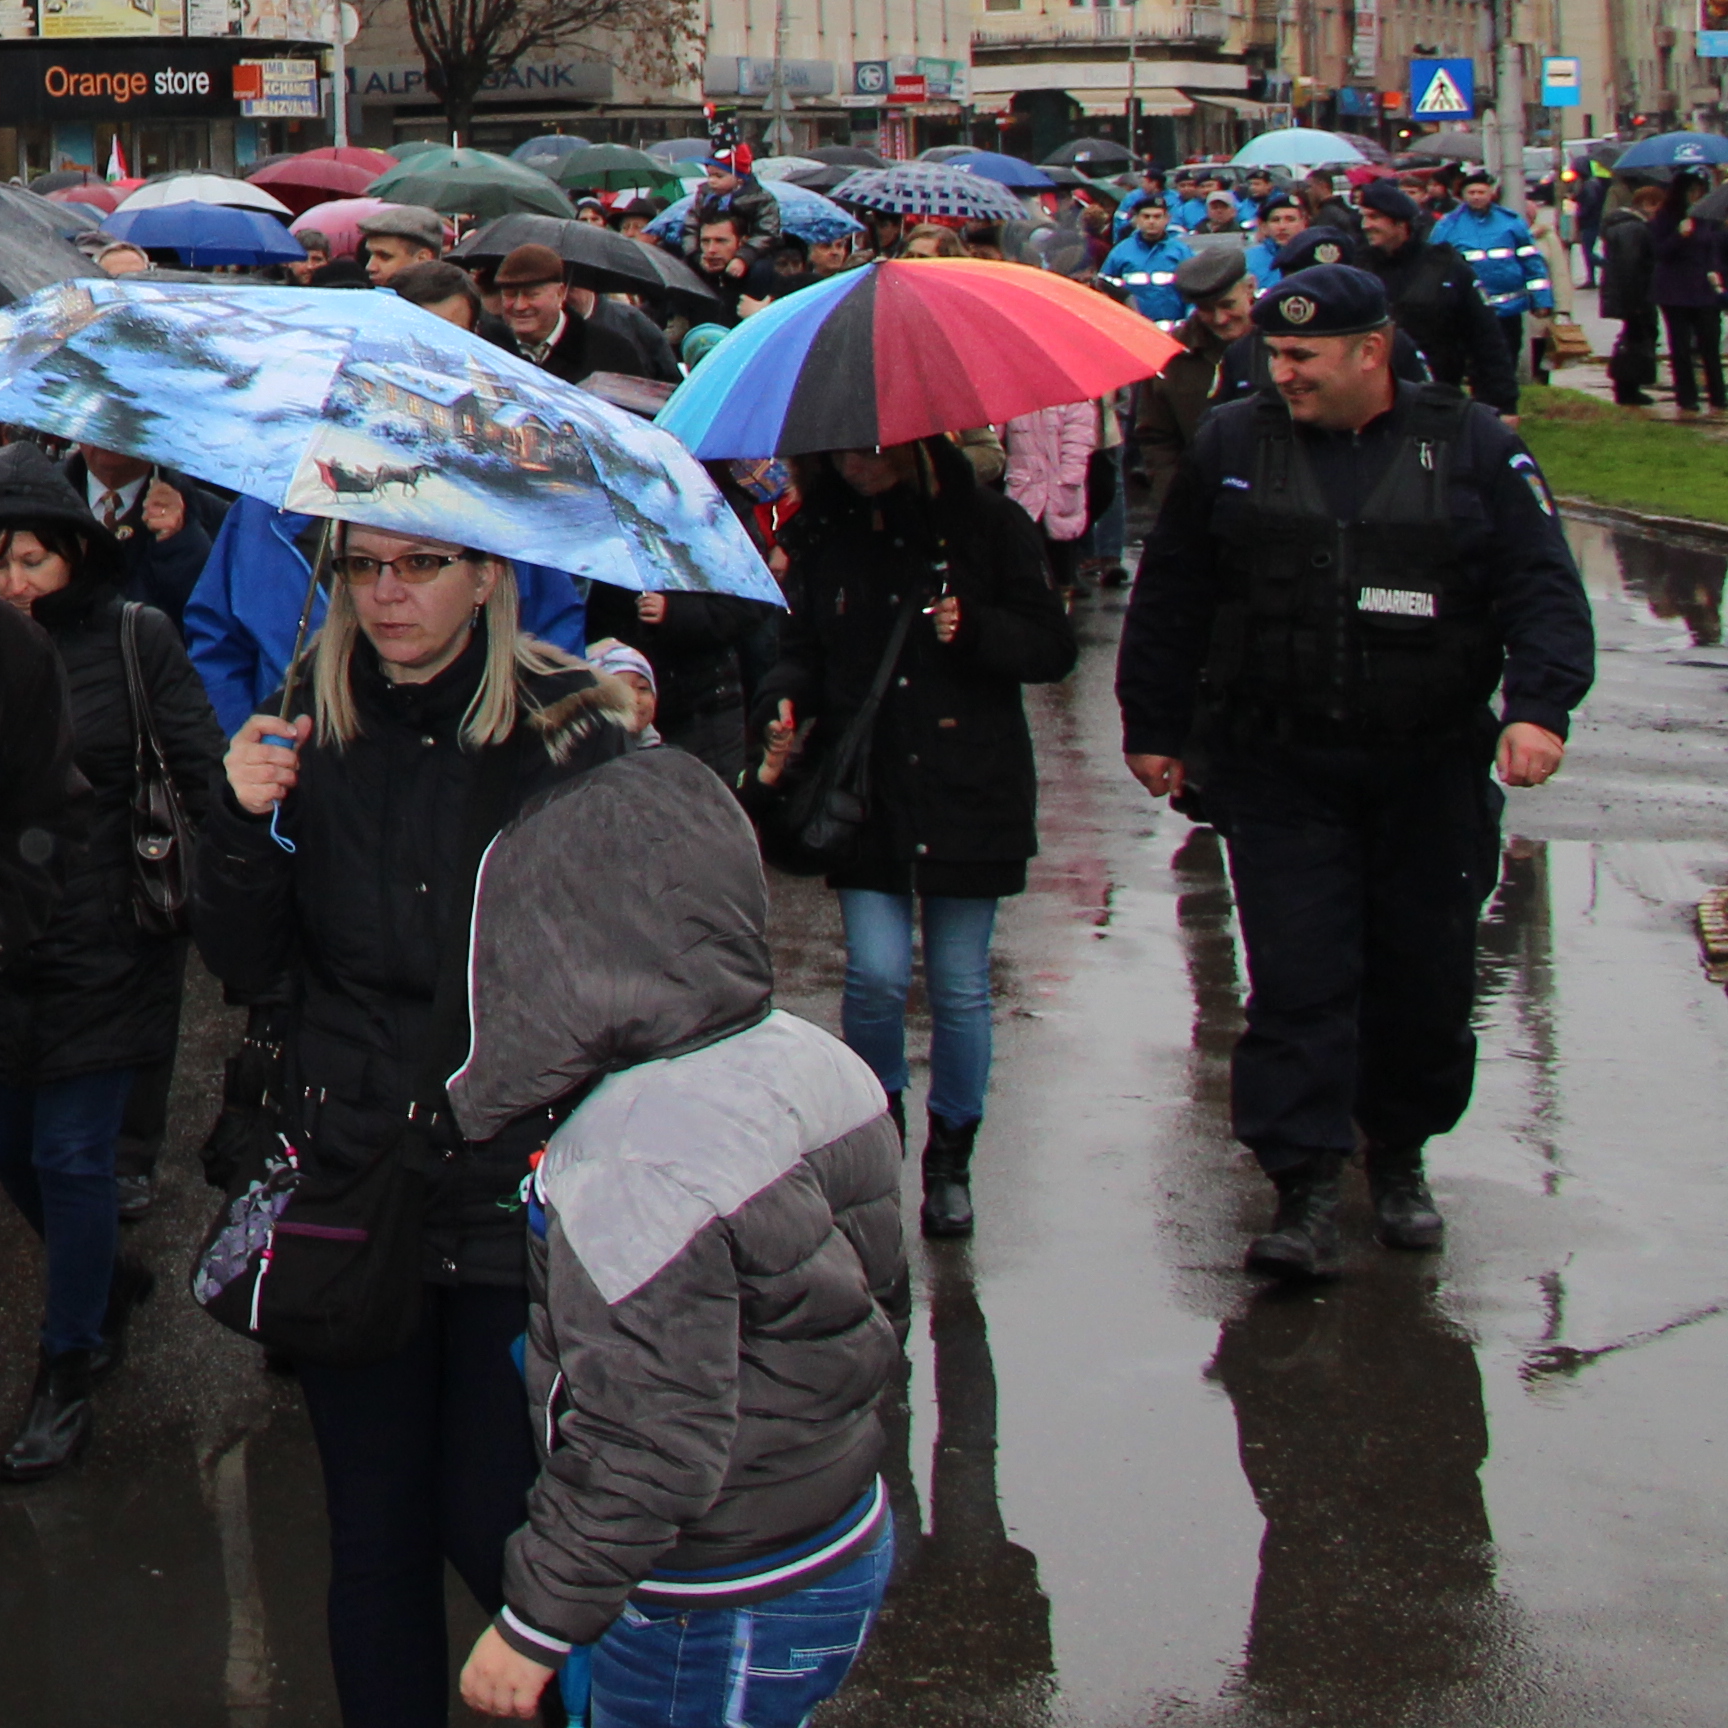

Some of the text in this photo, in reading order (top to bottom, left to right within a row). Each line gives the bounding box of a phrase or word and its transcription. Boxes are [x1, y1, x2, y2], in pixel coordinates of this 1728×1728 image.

[45, 65, 210, 103] Orange store
[261, 81, 311, 97] XCHANGE
[1357, 586, 1435, 618] JANDARMERIA
